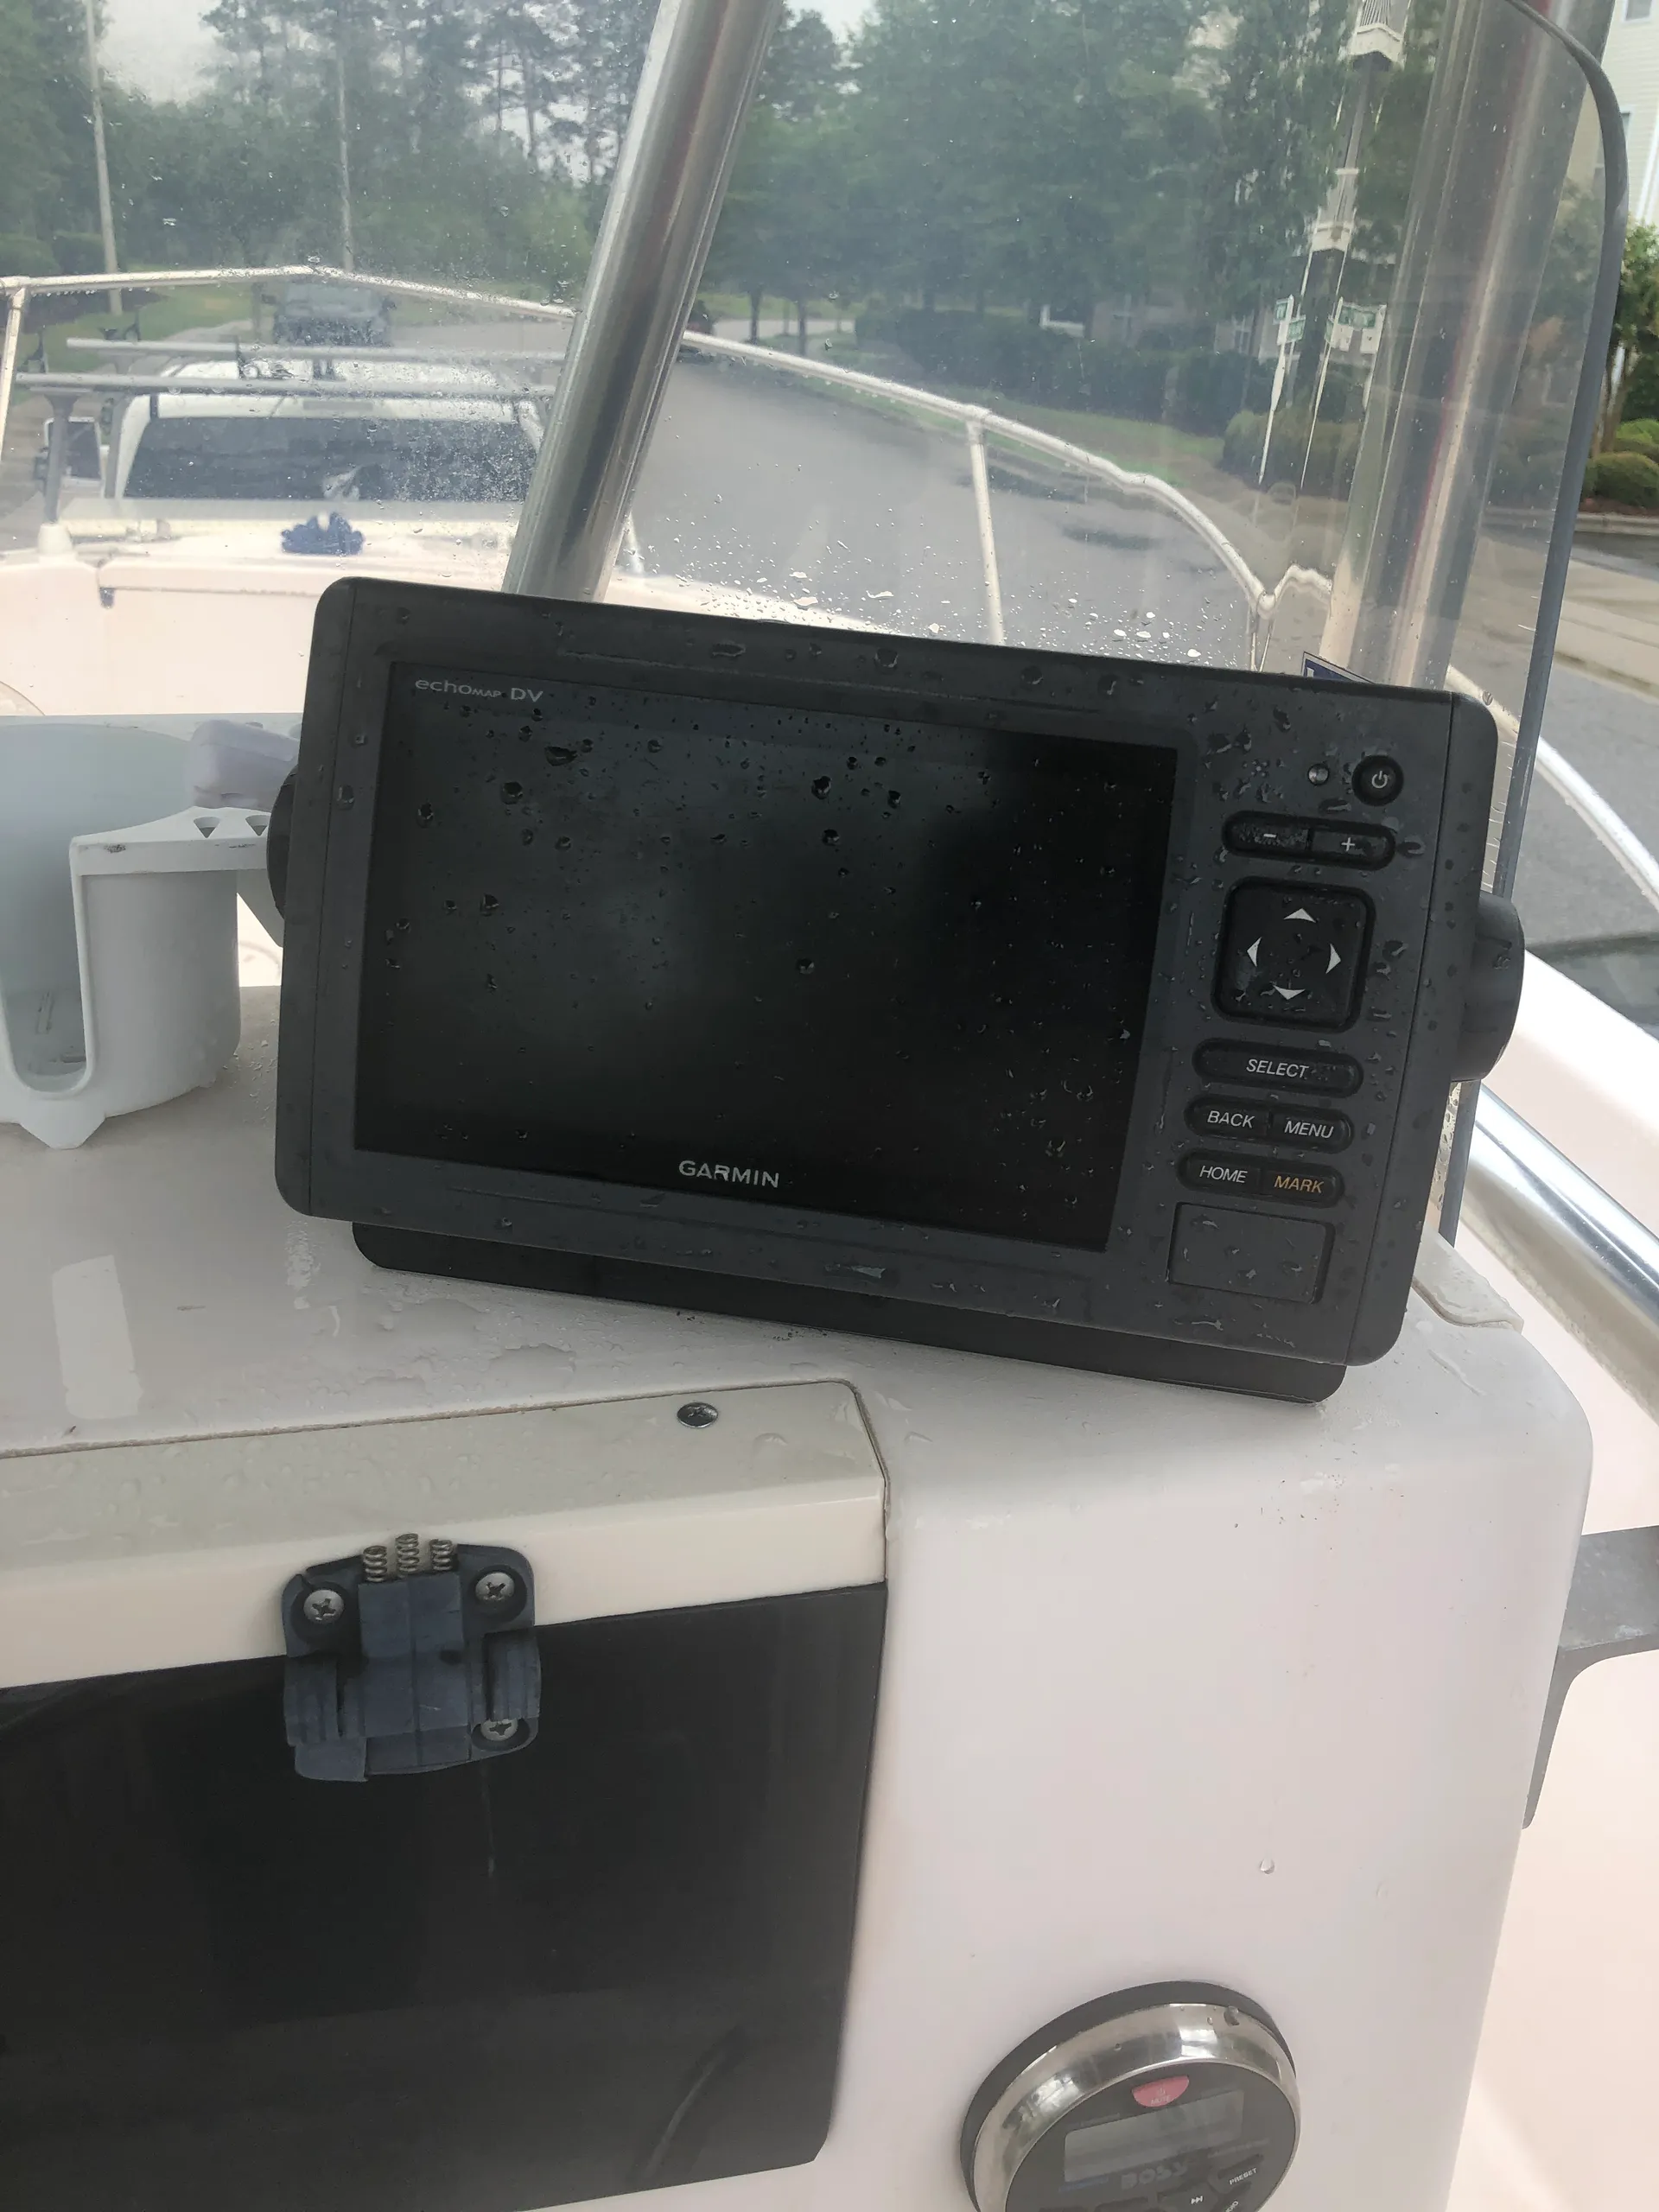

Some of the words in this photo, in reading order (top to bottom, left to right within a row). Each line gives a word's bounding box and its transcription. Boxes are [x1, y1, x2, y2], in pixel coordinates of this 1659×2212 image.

[511, 688, 543, 702] DV
[1246, 1058, 1309, 1078] SELECT
[1207, 1110, 1255, 1128] BACK
[1284, 1121, 1334, 1139] MENU
[678, 1160, 779, 1188] GARMIN
[1199, 1166, 1248, 1183] HOME
[1274, 1175, 1324, 1193] MARK
[1229, 2167, 1257, 2185] PRESET
